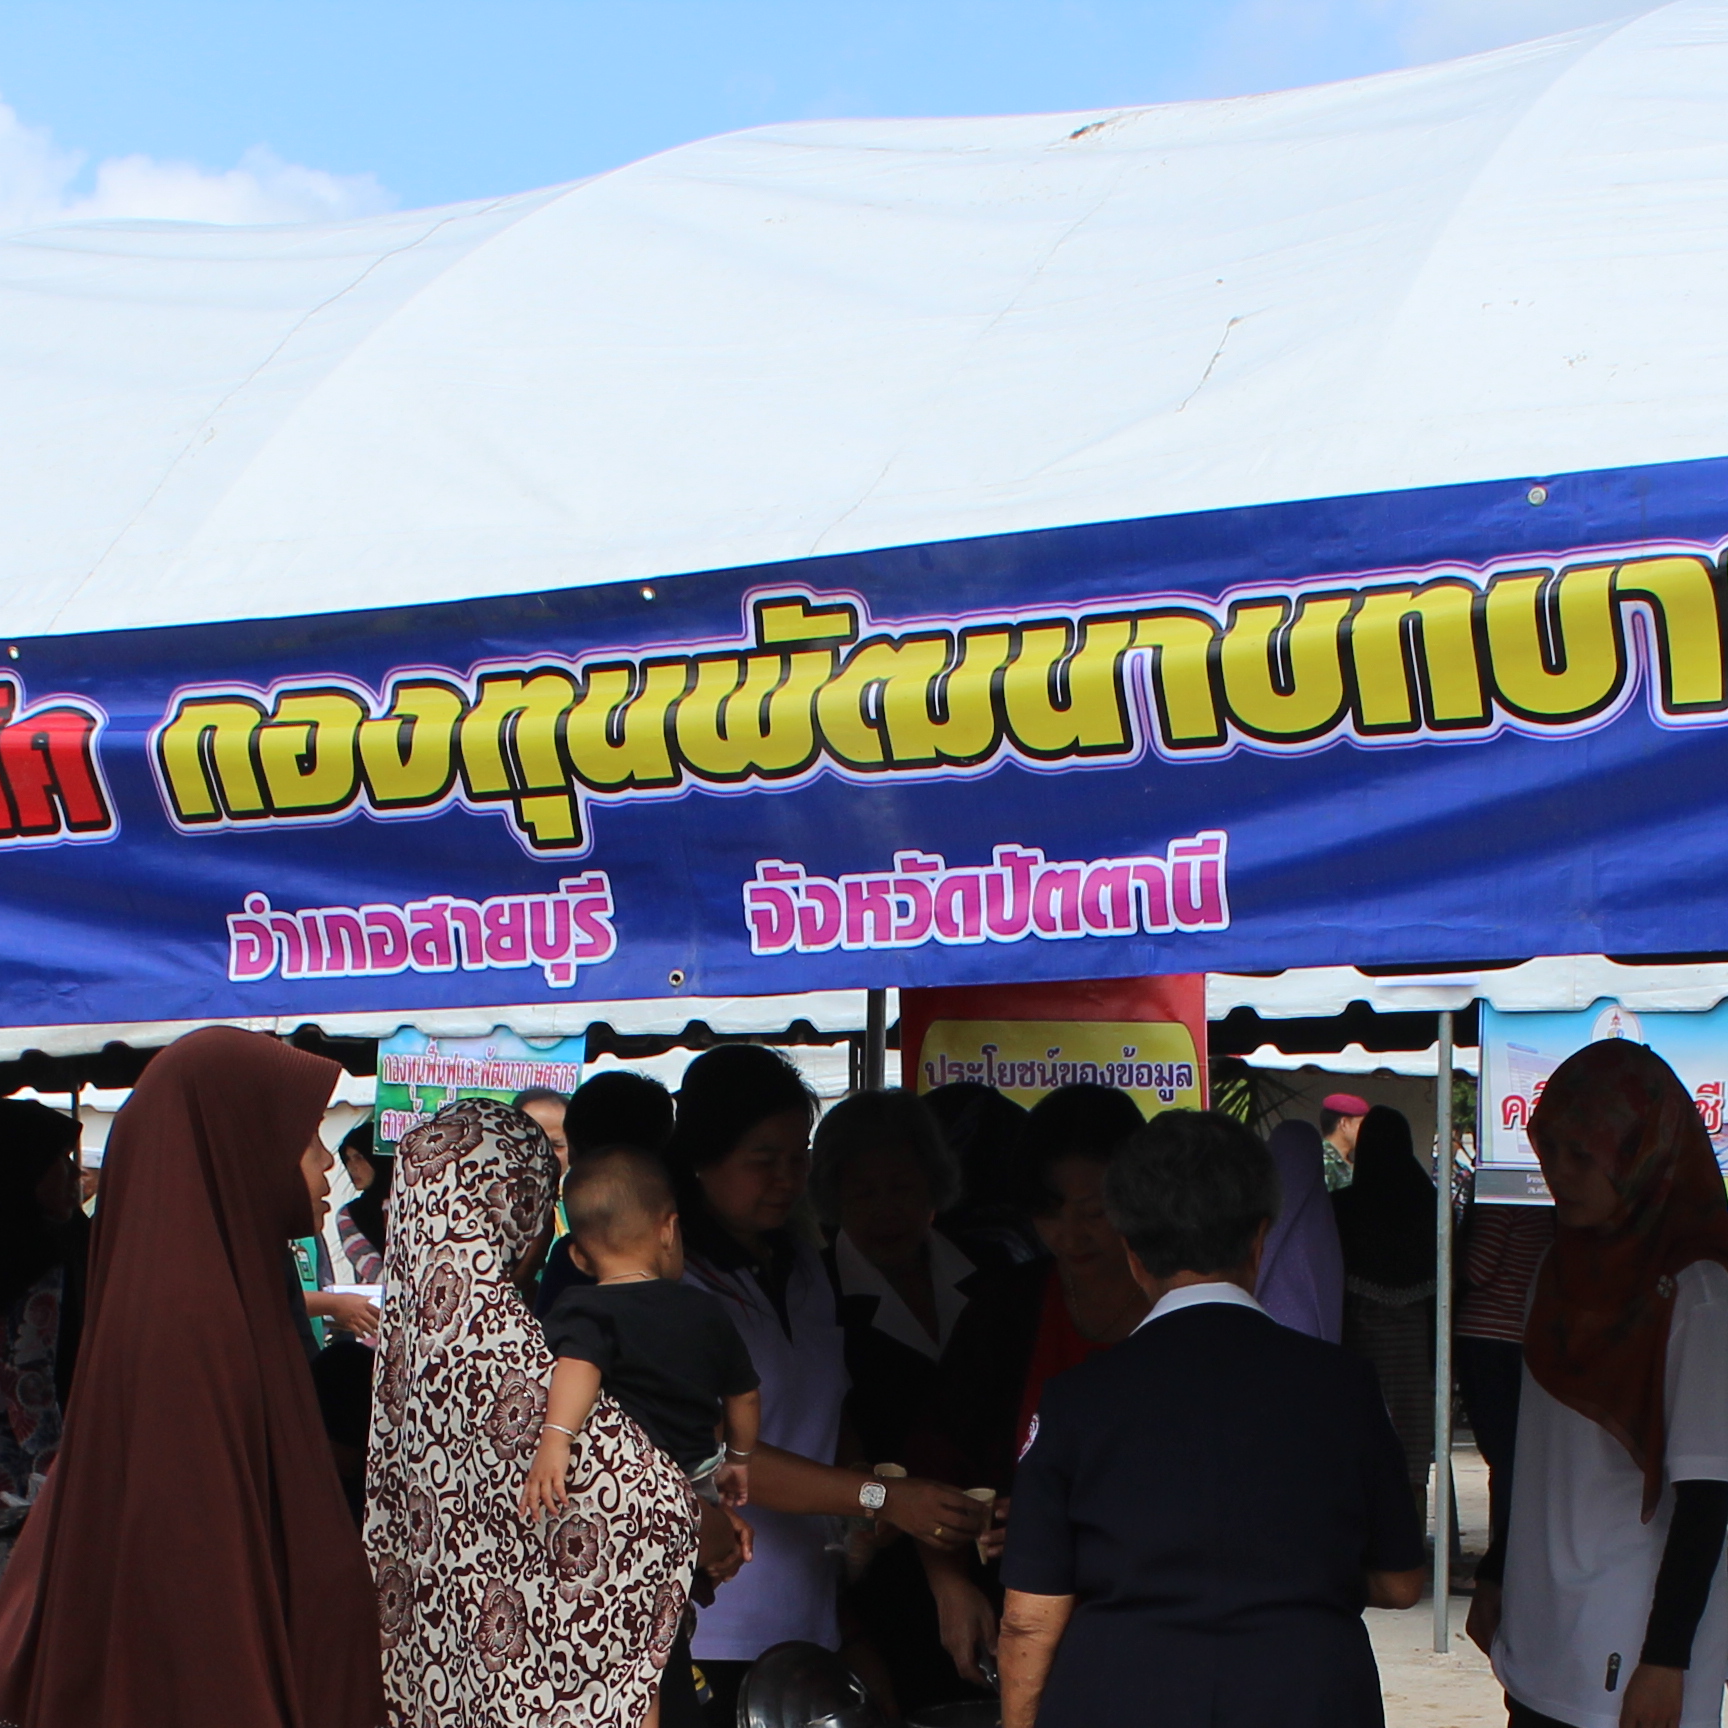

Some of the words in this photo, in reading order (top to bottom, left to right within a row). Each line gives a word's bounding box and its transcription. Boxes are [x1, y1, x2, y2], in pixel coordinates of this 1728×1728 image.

[232, 873, 615, 986] อำเภอสายบุรี
[747, 835, 1227, 955] จังหวัดปัตตานี
[925, 1045, 1193, 1103] ประโยชน์ของข้อมูล
